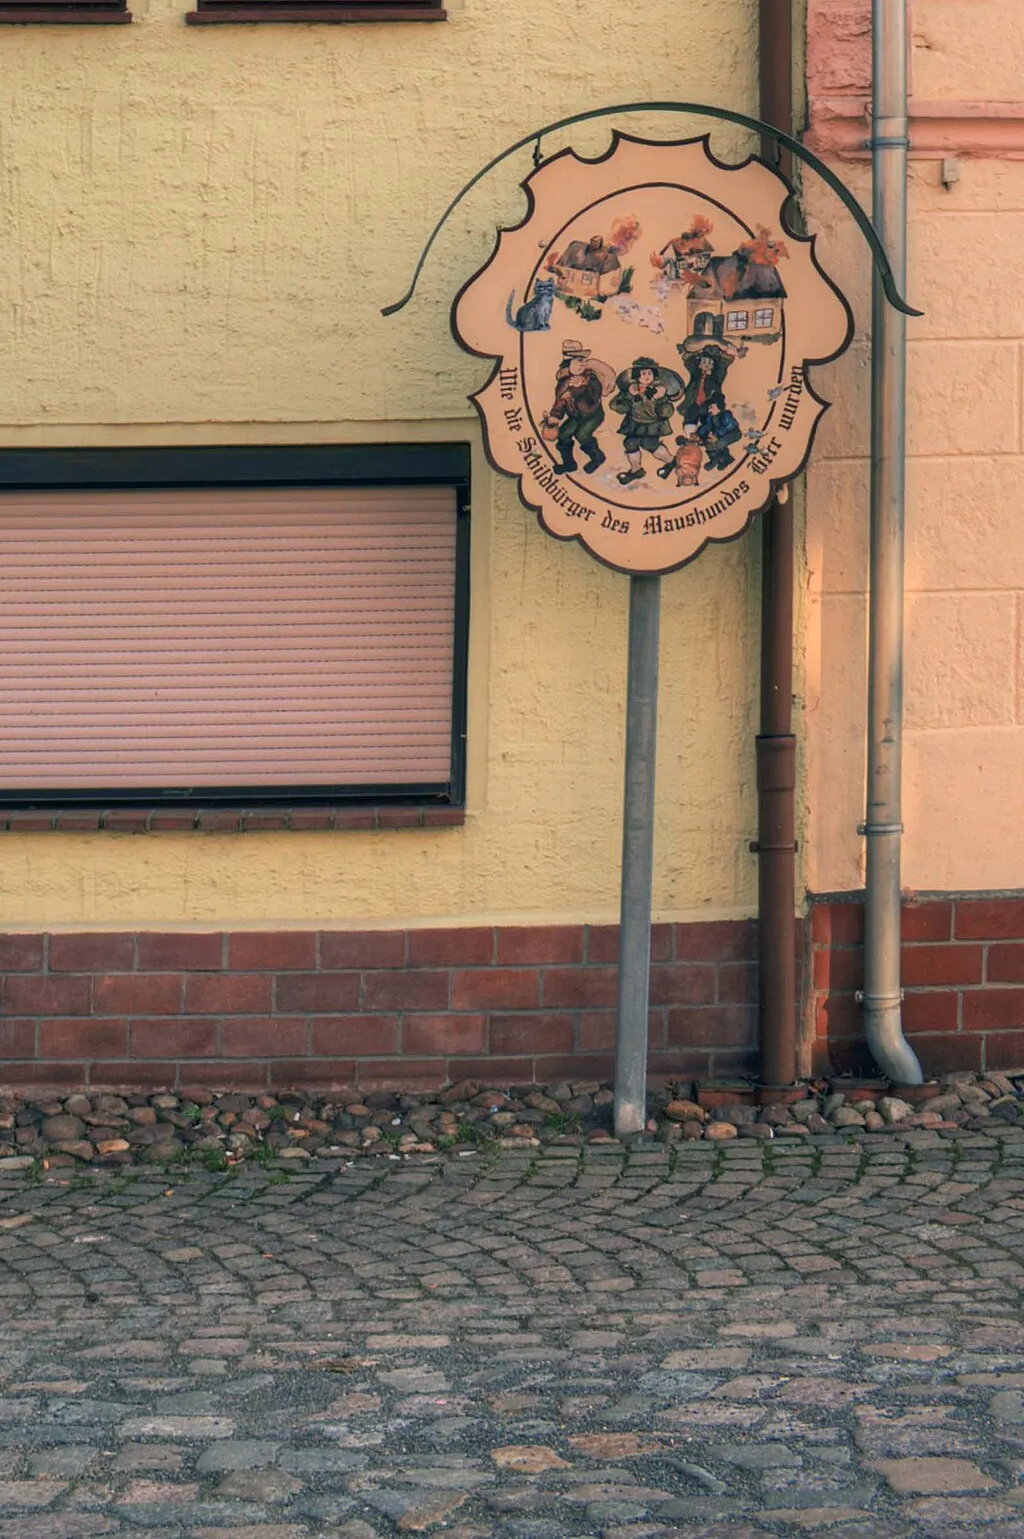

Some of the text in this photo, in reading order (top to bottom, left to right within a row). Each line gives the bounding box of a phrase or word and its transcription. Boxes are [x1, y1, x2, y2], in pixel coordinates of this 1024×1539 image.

[499, 365, 804, 536] Wie die Schildbürger des Maushundes Herr wurden
